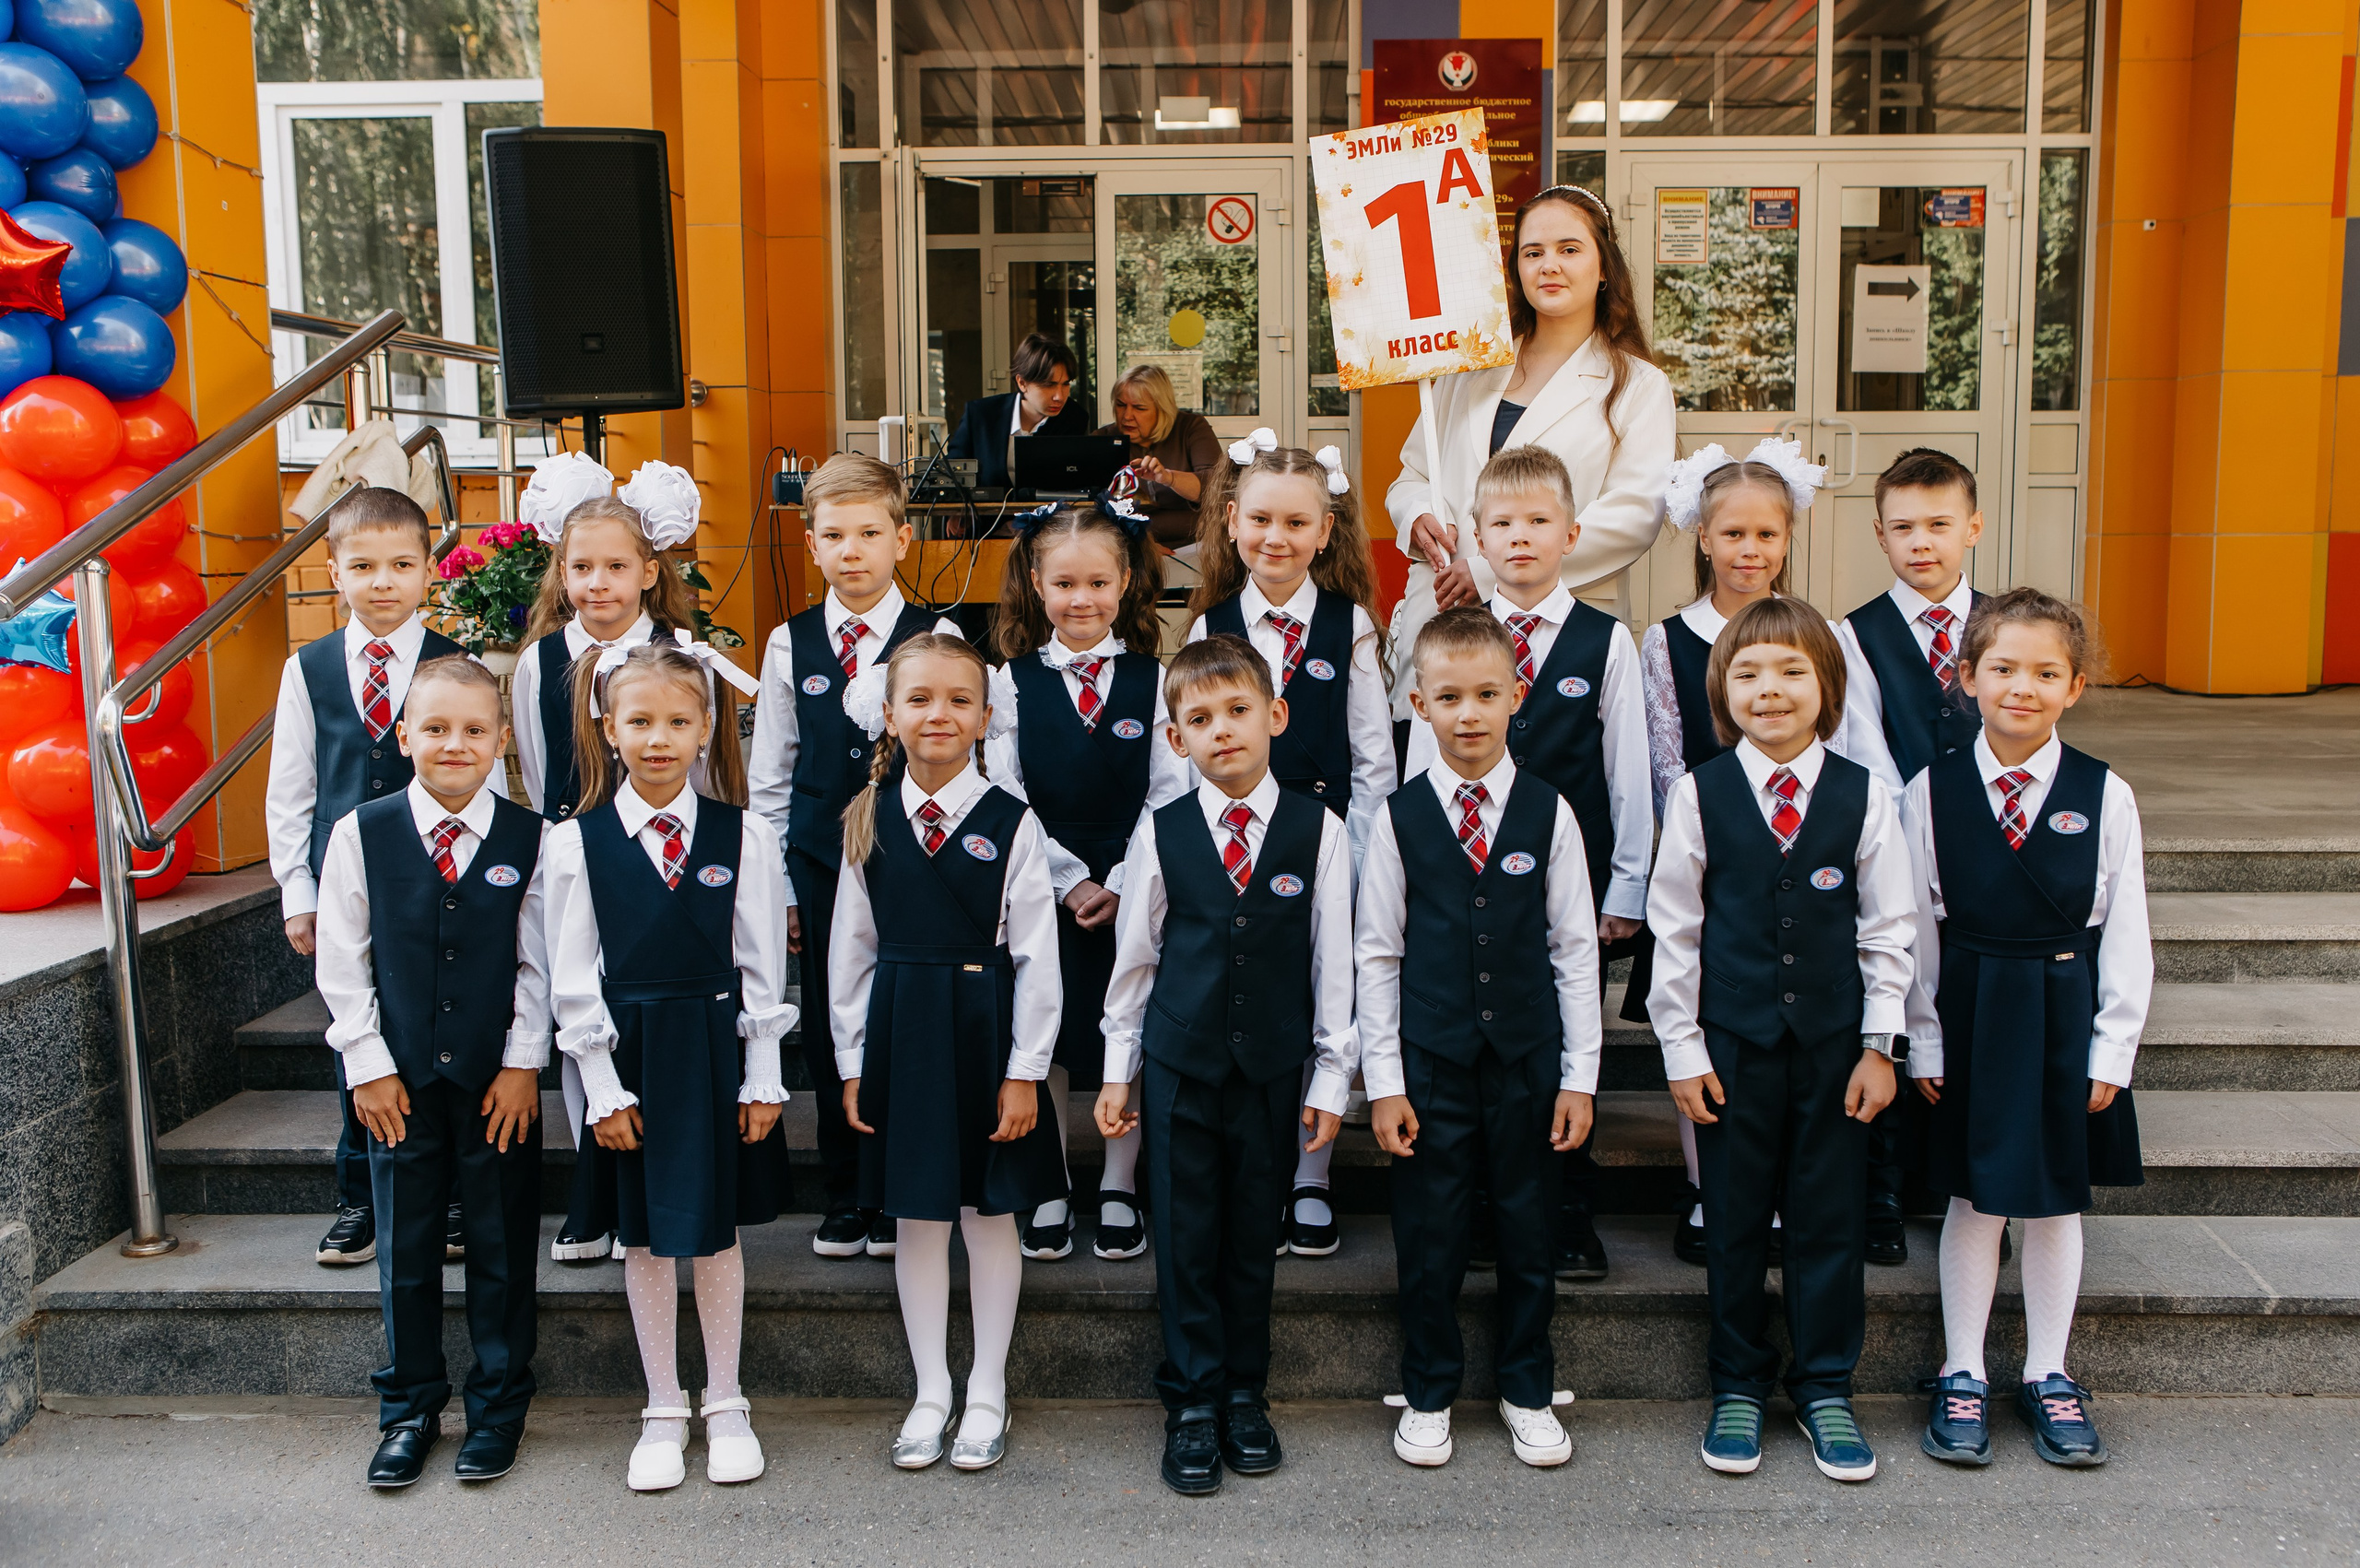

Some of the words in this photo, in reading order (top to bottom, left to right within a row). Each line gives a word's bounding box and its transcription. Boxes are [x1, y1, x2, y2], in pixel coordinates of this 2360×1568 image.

[1385, 98, 1471, 108] государственное
[1473, 97, 1532, 107] бюджетное
[1411, 124, 1458, 149] №29
[1387, 330, 1459, 360] класс
